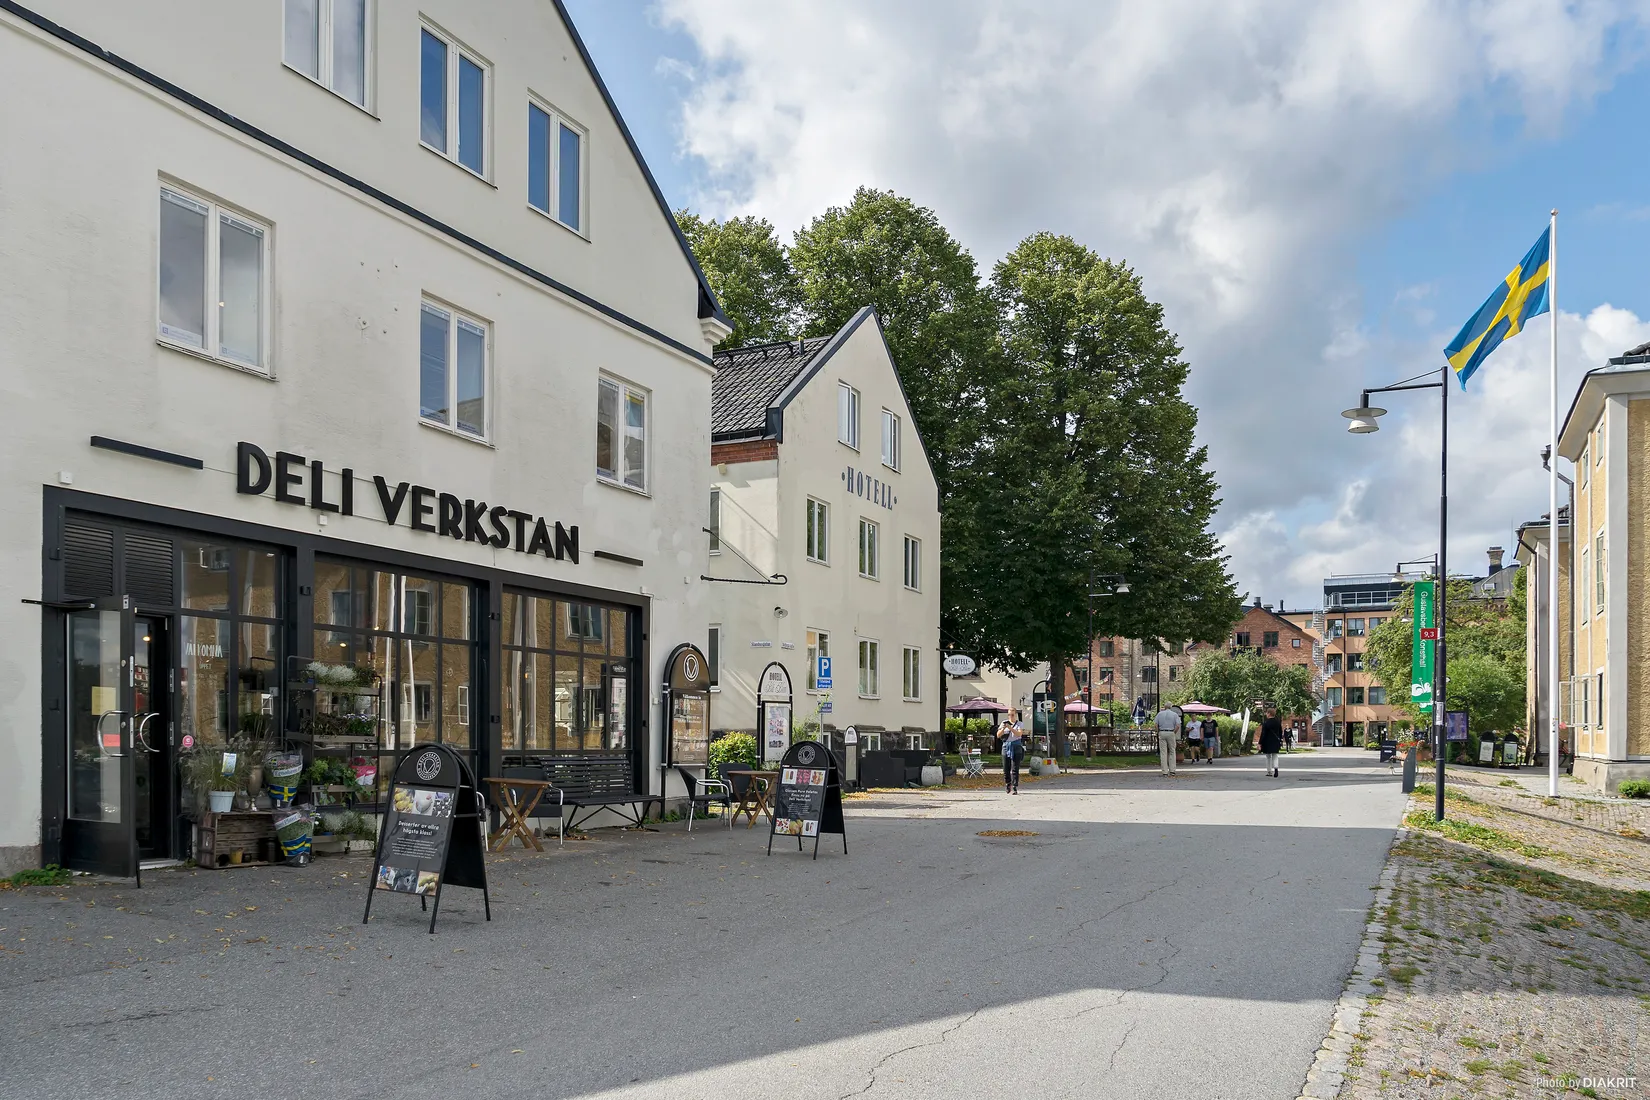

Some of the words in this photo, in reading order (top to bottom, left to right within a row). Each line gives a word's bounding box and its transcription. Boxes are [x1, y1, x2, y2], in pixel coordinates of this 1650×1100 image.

[237, 441, 353, 516] DELI
[373, 475, 580, 565] VERKSTAN
[847, 466, 893, 511] HOTELL
[1419, 591, 1428, 633] Gustavsber
[821, 658, 830, 676] P
